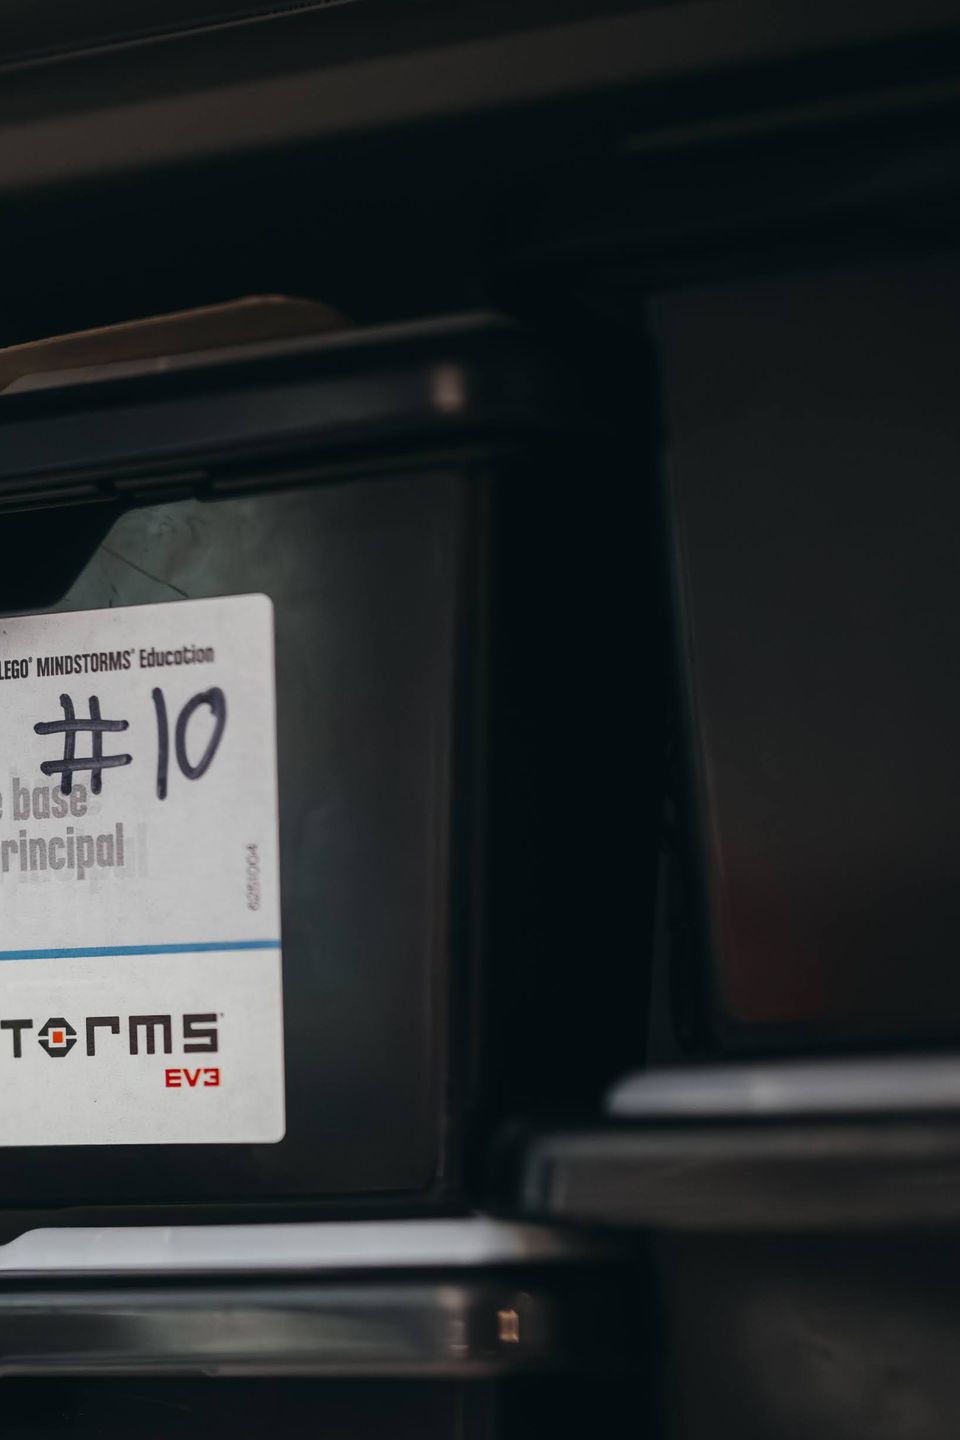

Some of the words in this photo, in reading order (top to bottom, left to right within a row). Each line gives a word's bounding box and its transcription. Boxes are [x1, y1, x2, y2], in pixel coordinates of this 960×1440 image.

[139, 645, 216, 669] Education
[12, 777, 89, 821] base
[165, 1068, 221, 1088] EV3
